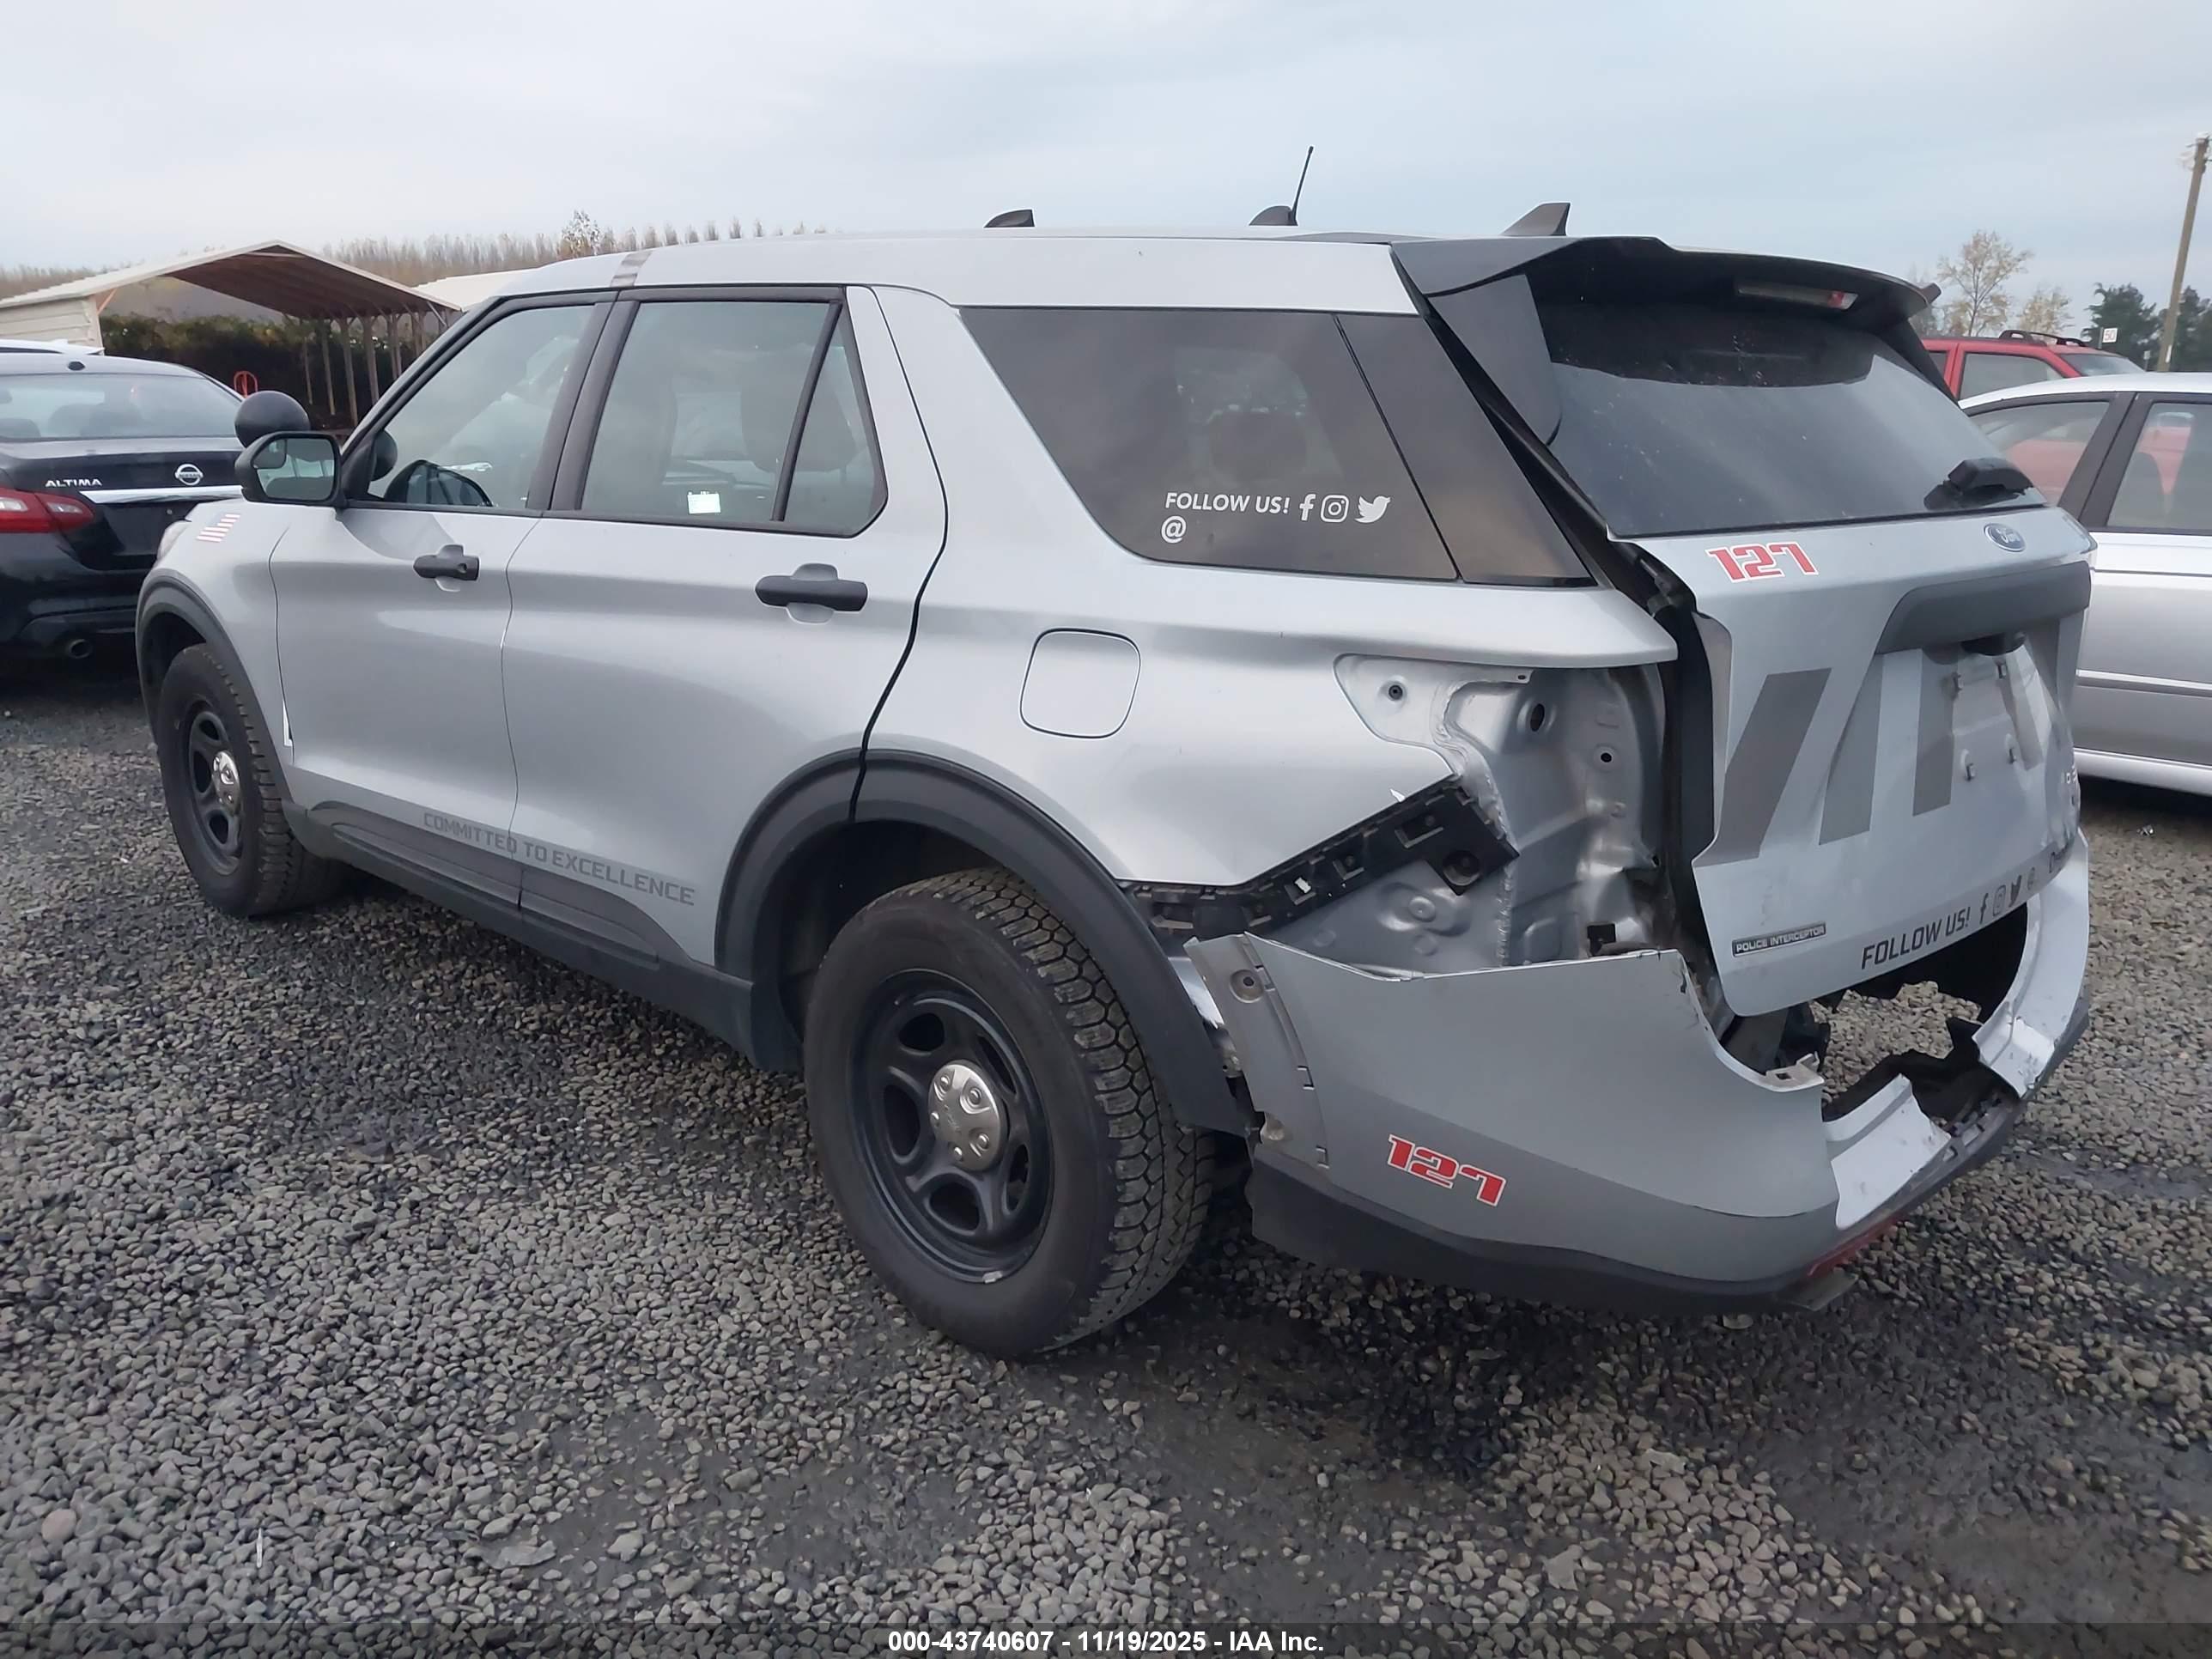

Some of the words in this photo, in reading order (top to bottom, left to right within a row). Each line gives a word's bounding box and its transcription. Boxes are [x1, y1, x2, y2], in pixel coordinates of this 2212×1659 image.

[45, 478, 102, 488] ALTIMA
[1165, 492, 1250, 512] FOLLOW
[1255, 495, 1291, 514] US!
[1161, 515, 1187, 544] @
[1705, 542, 1819, 583] 127
[423, 812, 517, 853] COMMITTED
[524, 842, 548, 863] TO
[552, 851, 696, 906] EXCELLENCE
[1736, 939, 1768, 953] POLICE
[1770, 926, 1825, 946] INTERCEPTOR
[1861, 919, 1942, 970] FOLLOW
[1945, 906, 1972, 937] US!
[1388, 1134, 1506, 1206] 127
